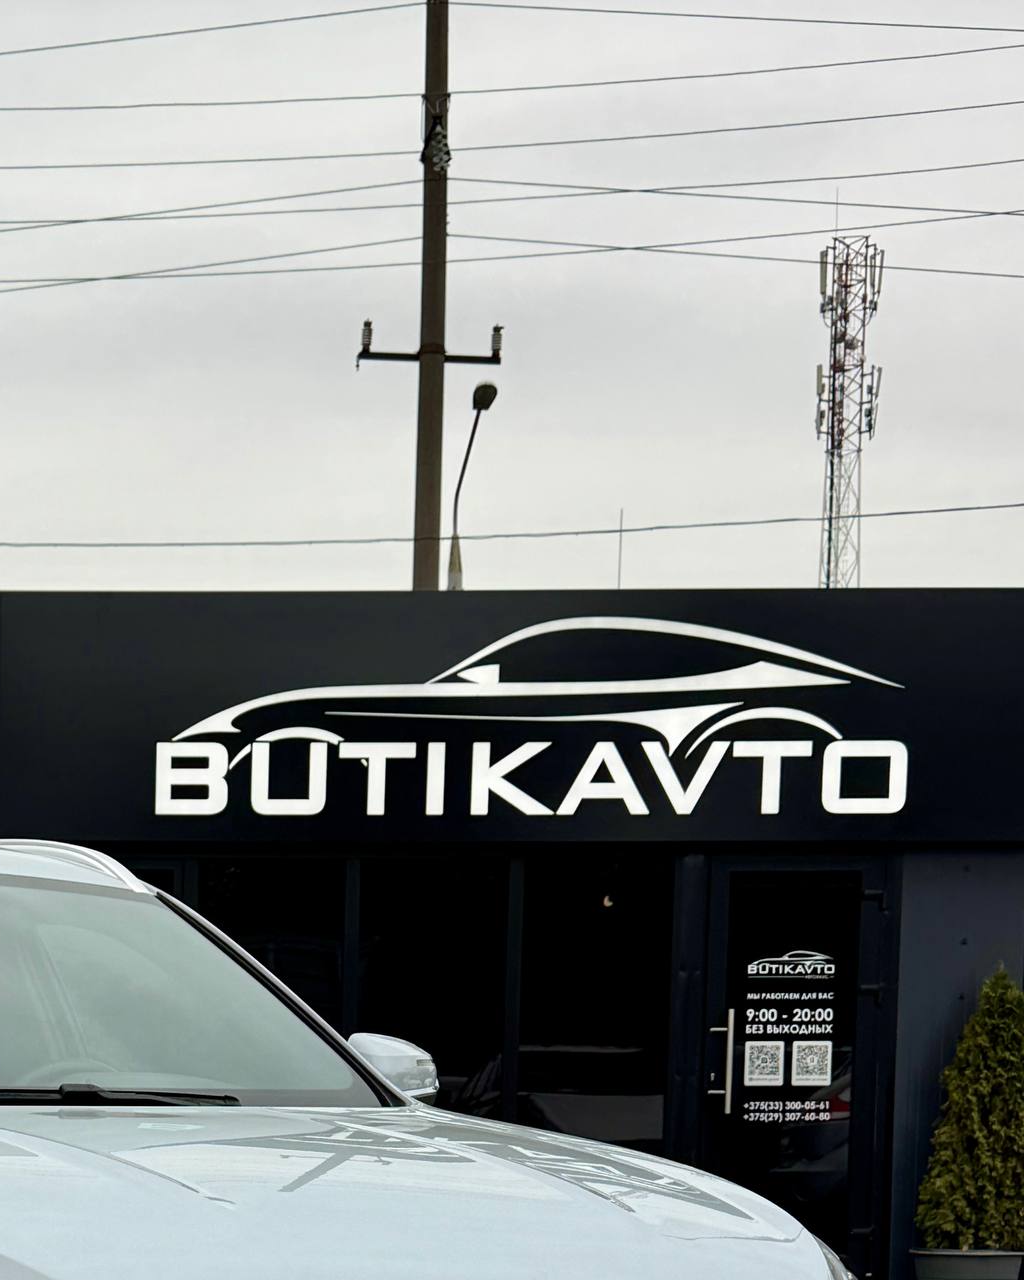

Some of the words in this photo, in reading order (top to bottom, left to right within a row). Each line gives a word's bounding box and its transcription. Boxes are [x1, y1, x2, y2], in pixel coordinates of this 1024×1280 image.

[154, 738, 910, 817] BUTIKAVTO
[747, 963, 835, 974] BUTIKAVTO
[747, 992, 760, 1000] МЫ
[761, 992, 800, 1000] РАБОТАЕМ
[801, 992, 817, 1000] ДЛЯ
[818, 992, 834, 1000] ВАС
[746, 1008, 778, 1022] 9:00
[792, 1008, 834, 1022] 20:00
[745, 1024, 764, 1034] БЕЗ
[766, 1024, 833, 1035] ВЫХОДНЫХ
[743, 1101, 783, 1111] +375(33)
[785, 1101, 830, 1110] 300-05-61
[743, 1112, 783, 1123] +375(29)
[785, 1112, 831, 1121] 307-60-80
